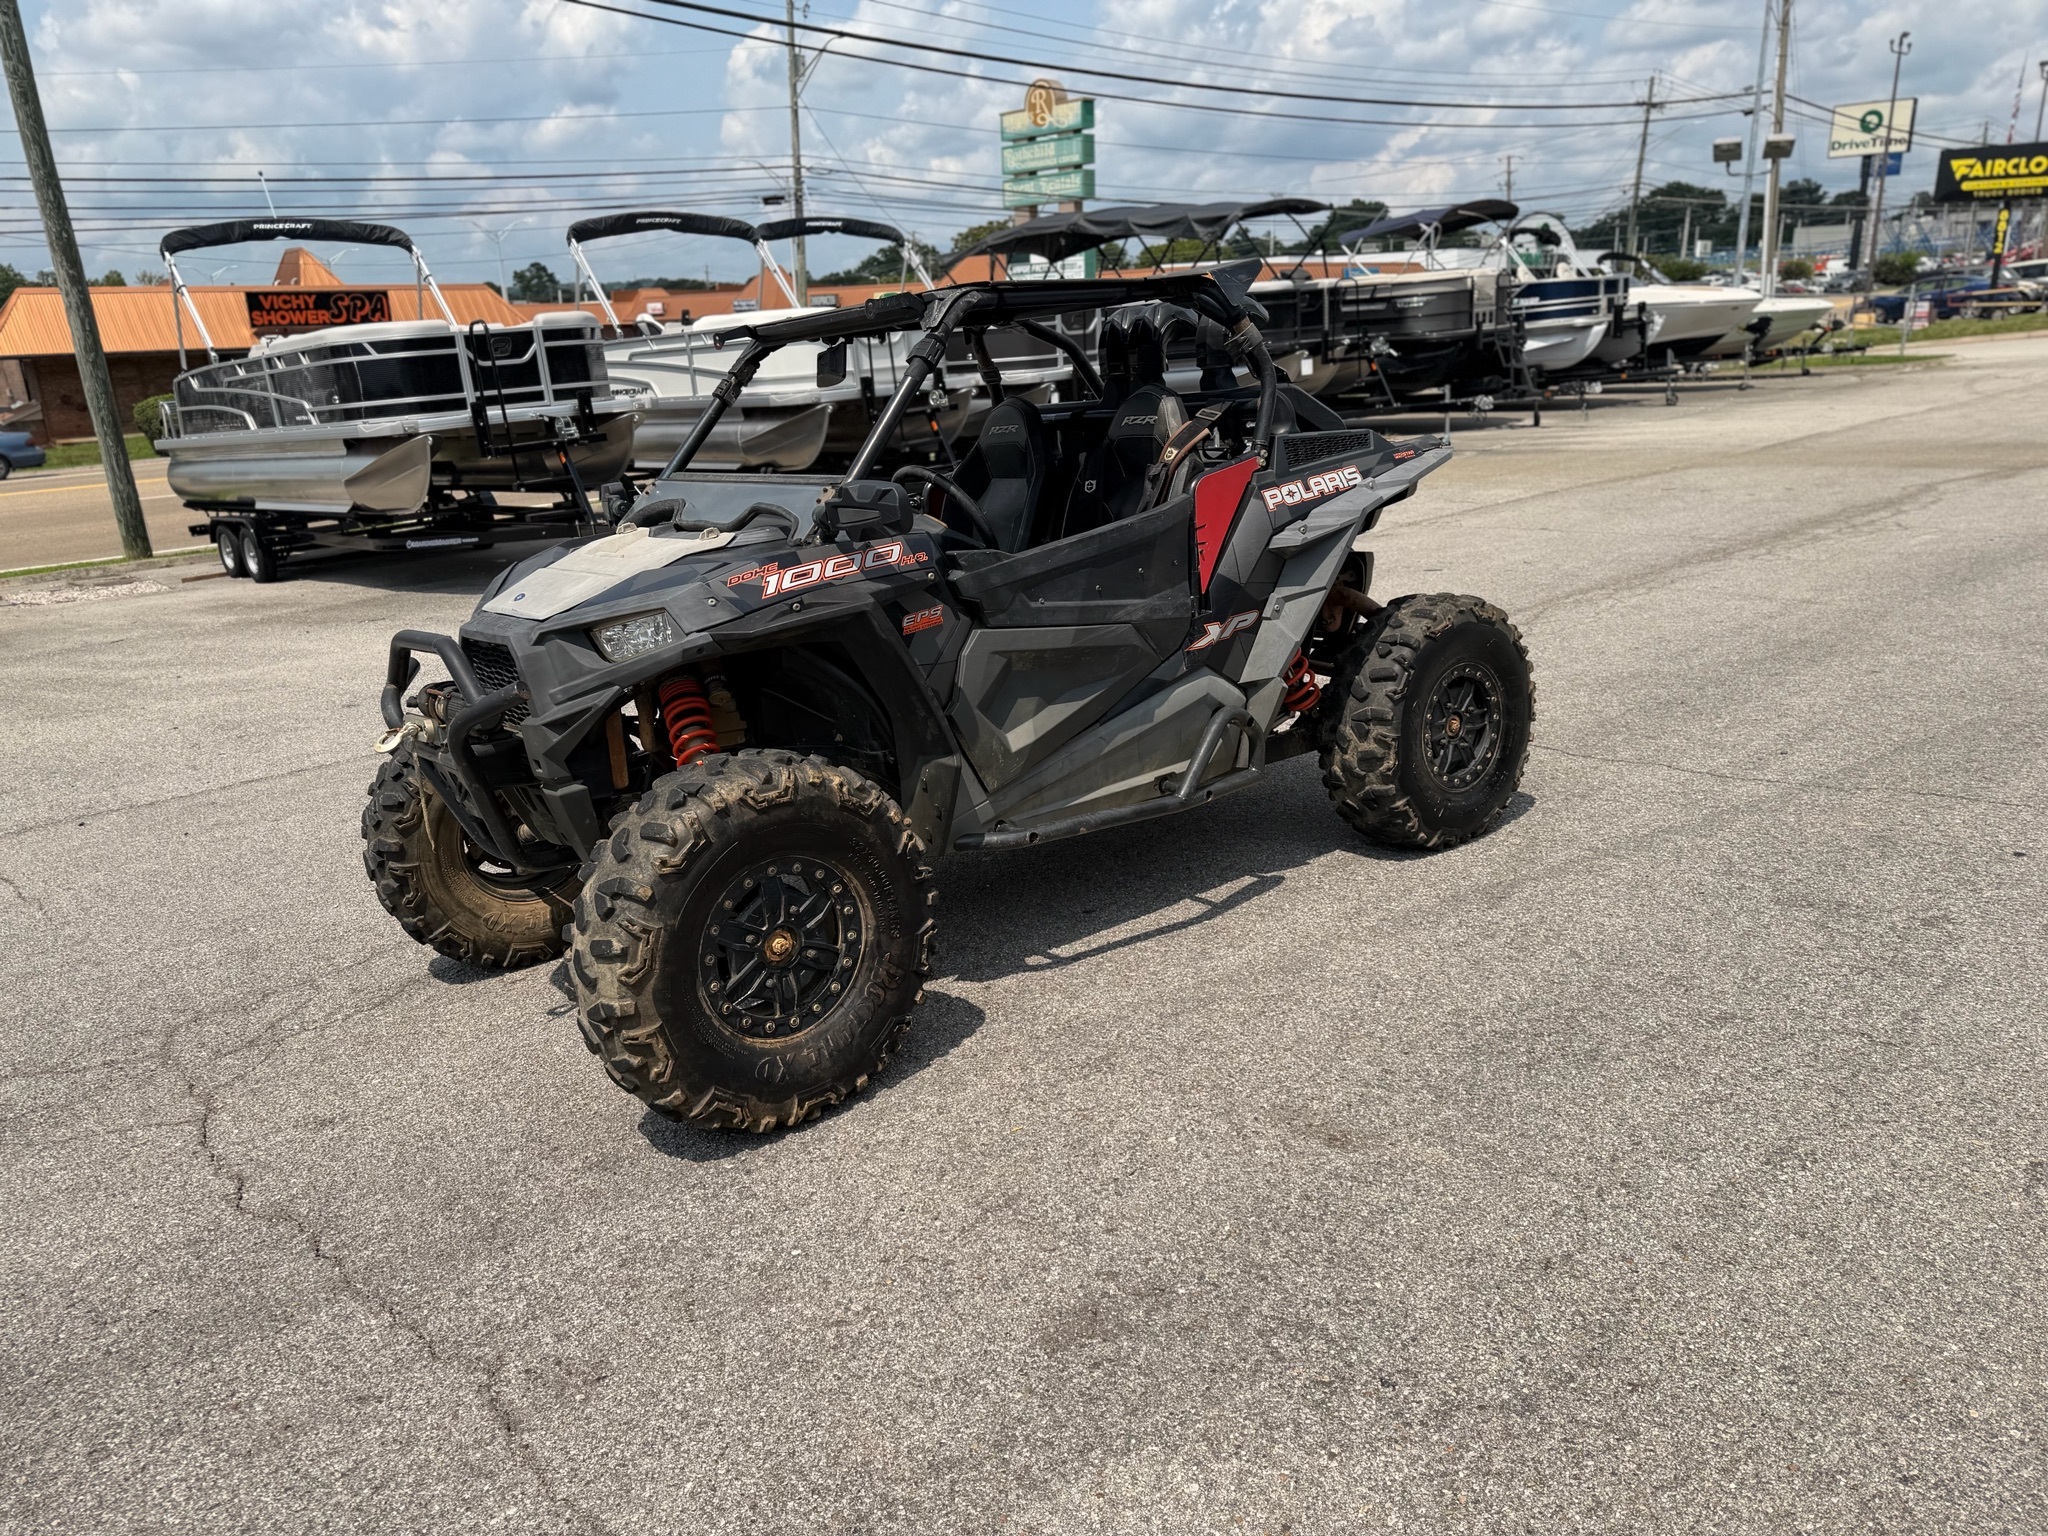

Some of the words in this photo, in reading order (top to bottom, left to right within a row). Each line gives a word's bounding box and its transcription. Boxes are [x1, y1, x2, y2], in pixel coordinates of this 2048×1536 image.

[252, 310, 331, 325] SHOWER
[329, 293, 390, 323] SPA
[258, 294, 317, 310] VICHY
[988, 424, 1019, 436] RZR
[1120, 415, 1158, 427] RZR
[1261, 464, 1364, 512] POLARIS
[726, 562, 778, 587] DOHC
[762, 541, 904, 599] 1000
[902, 605, 943, 627] EPS
[1184, 610, 1260, 651] XP
